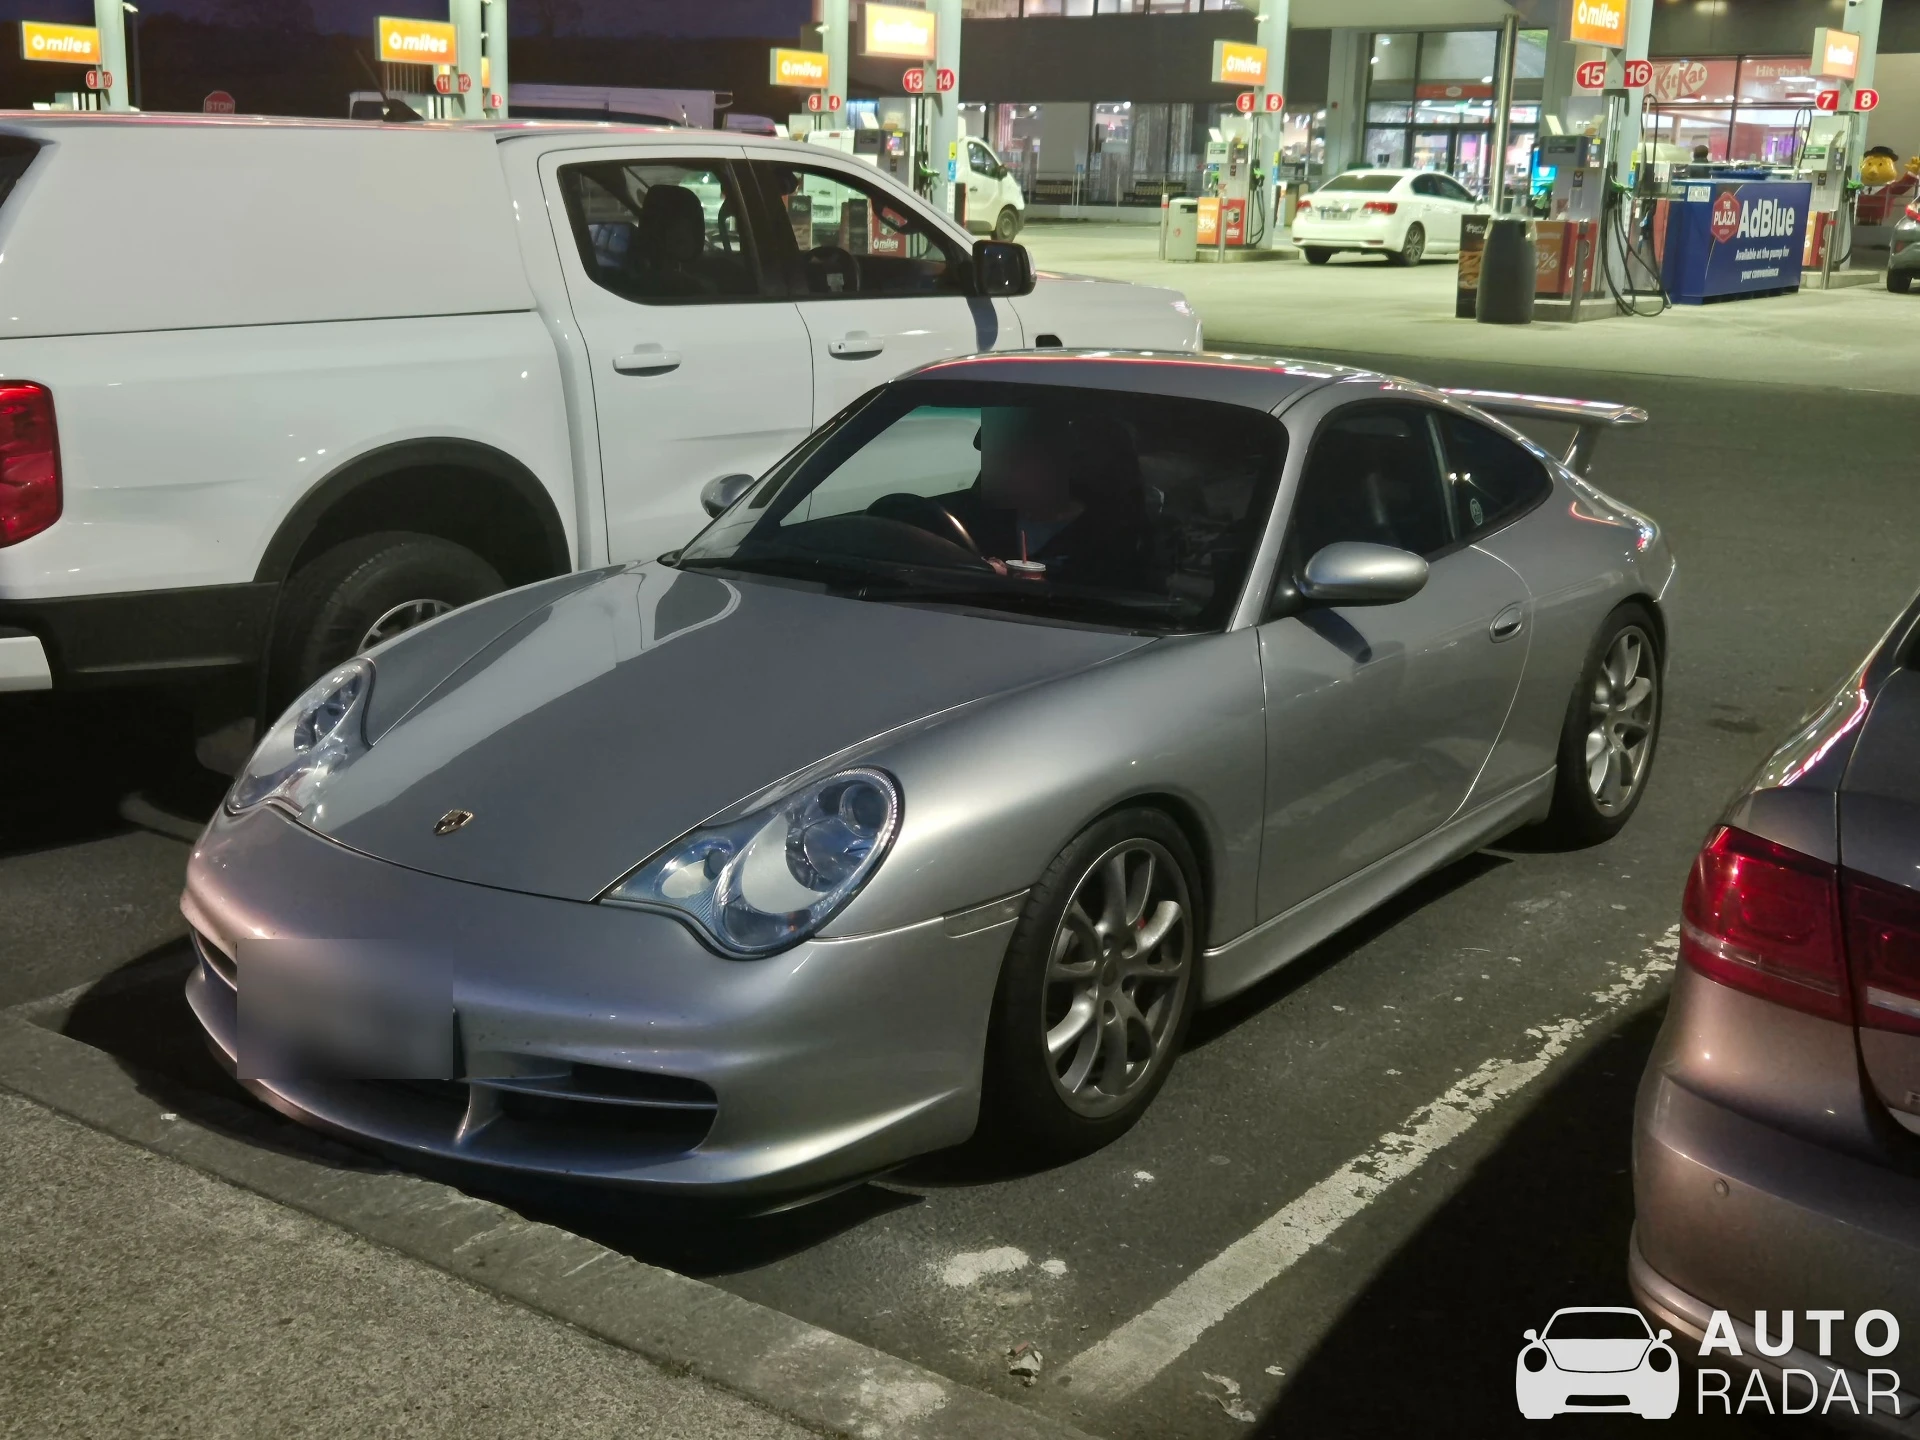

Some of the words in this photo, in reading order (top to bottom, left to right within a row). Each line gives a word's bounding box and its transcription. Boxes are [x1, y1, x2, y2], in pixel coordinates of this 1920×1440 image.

[1581, 65, 1604, 85] 15
[1626, 64, 1649, 84] 16
[1756, 65, 1775, 77] Hit
[89, 72, 95, 86] 9
[103, 73, 112, 87] 10
[440, 76, 449, 90] 11
[459, 76, 469, 90] 12
[907, 73, 923, 88] 13
[937, 73, 951, 88] 14
[1654, 62, 1706, 99] KitKat
[206, 100, 232, 112] STOP
[495, 97, 502, 108] 2
[811, 97, 818, 109] 3
[831, 97, 838, 109] 4
[1242, 96, 1250, 110] 5
[1270, 95, 1279, 110] 6
[1822, 93, 1833, 108] 7
[1861, 92, 1872, 108] 8
[1713, 211, 1736, 225] PLAZA
[1736, 198, 1795, 238] AdBlue
[1735, 247, 1756, 261] Available
[1752, 266, 1779, 279] convenience
